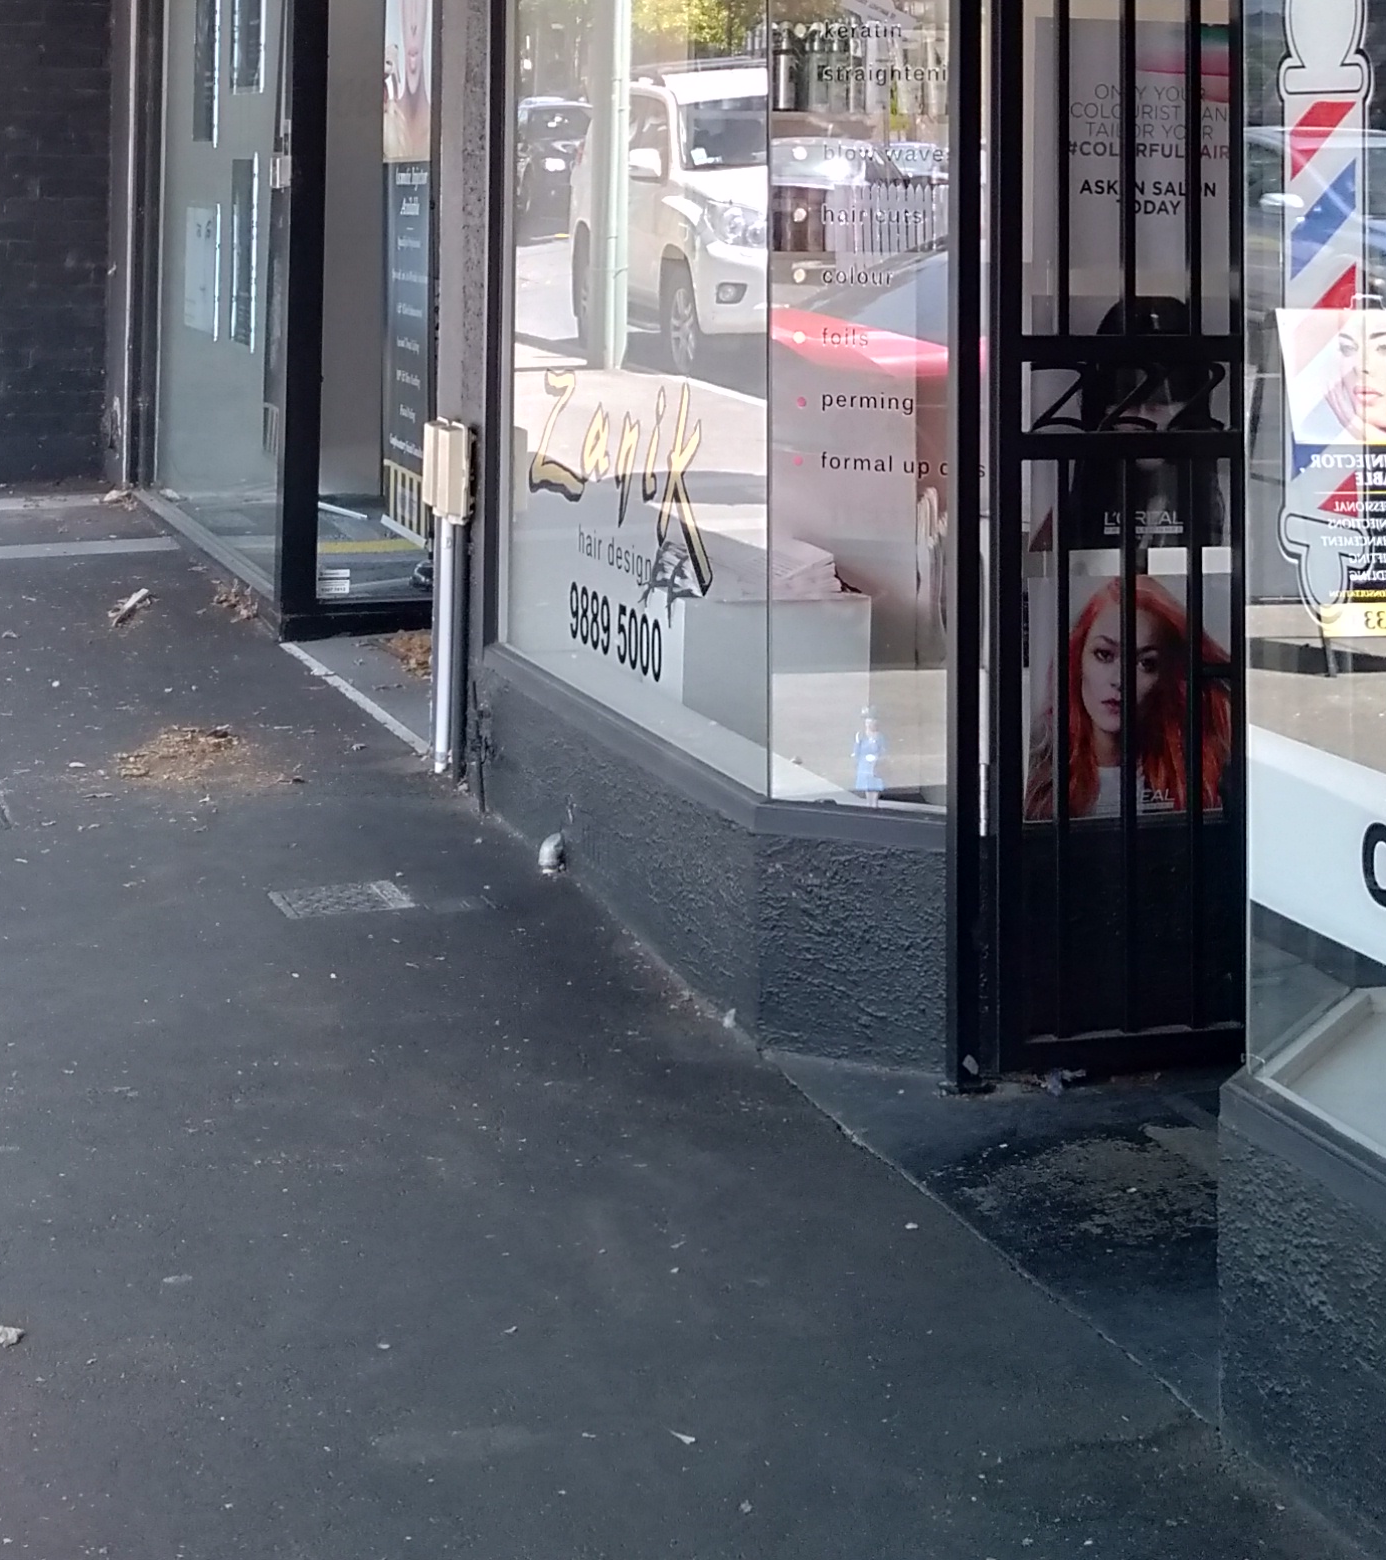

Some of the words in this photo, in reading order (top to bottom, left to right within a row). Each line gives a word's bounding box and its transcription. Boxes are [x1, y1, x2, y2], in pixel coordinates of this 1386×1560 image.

[824, 19, 903, 39] keratin
[1094, 83, 1148, 100] ONY
[1161, 124, 1214, 140] YOR
[1068, 140, 1230, 161] #COLRFULAIR
[1079, 179, 1118, 196] ASK
[1152, 181, 1216, 198] SALN
[1116, 199, 1181, 216] ODAY
[822, 266, 893, 286] colour
[821, 327, 869, 348] foils
[821, 392, 914, 416] perming
[821, 451, 893, 473] formal
[903, 461, 930, 478] up
[577, 524, 603, 561] hair
[607, 536, 652, 587] design
[569, 580, 610, 656] 9889
[616, 603, 661, 683] 5000
